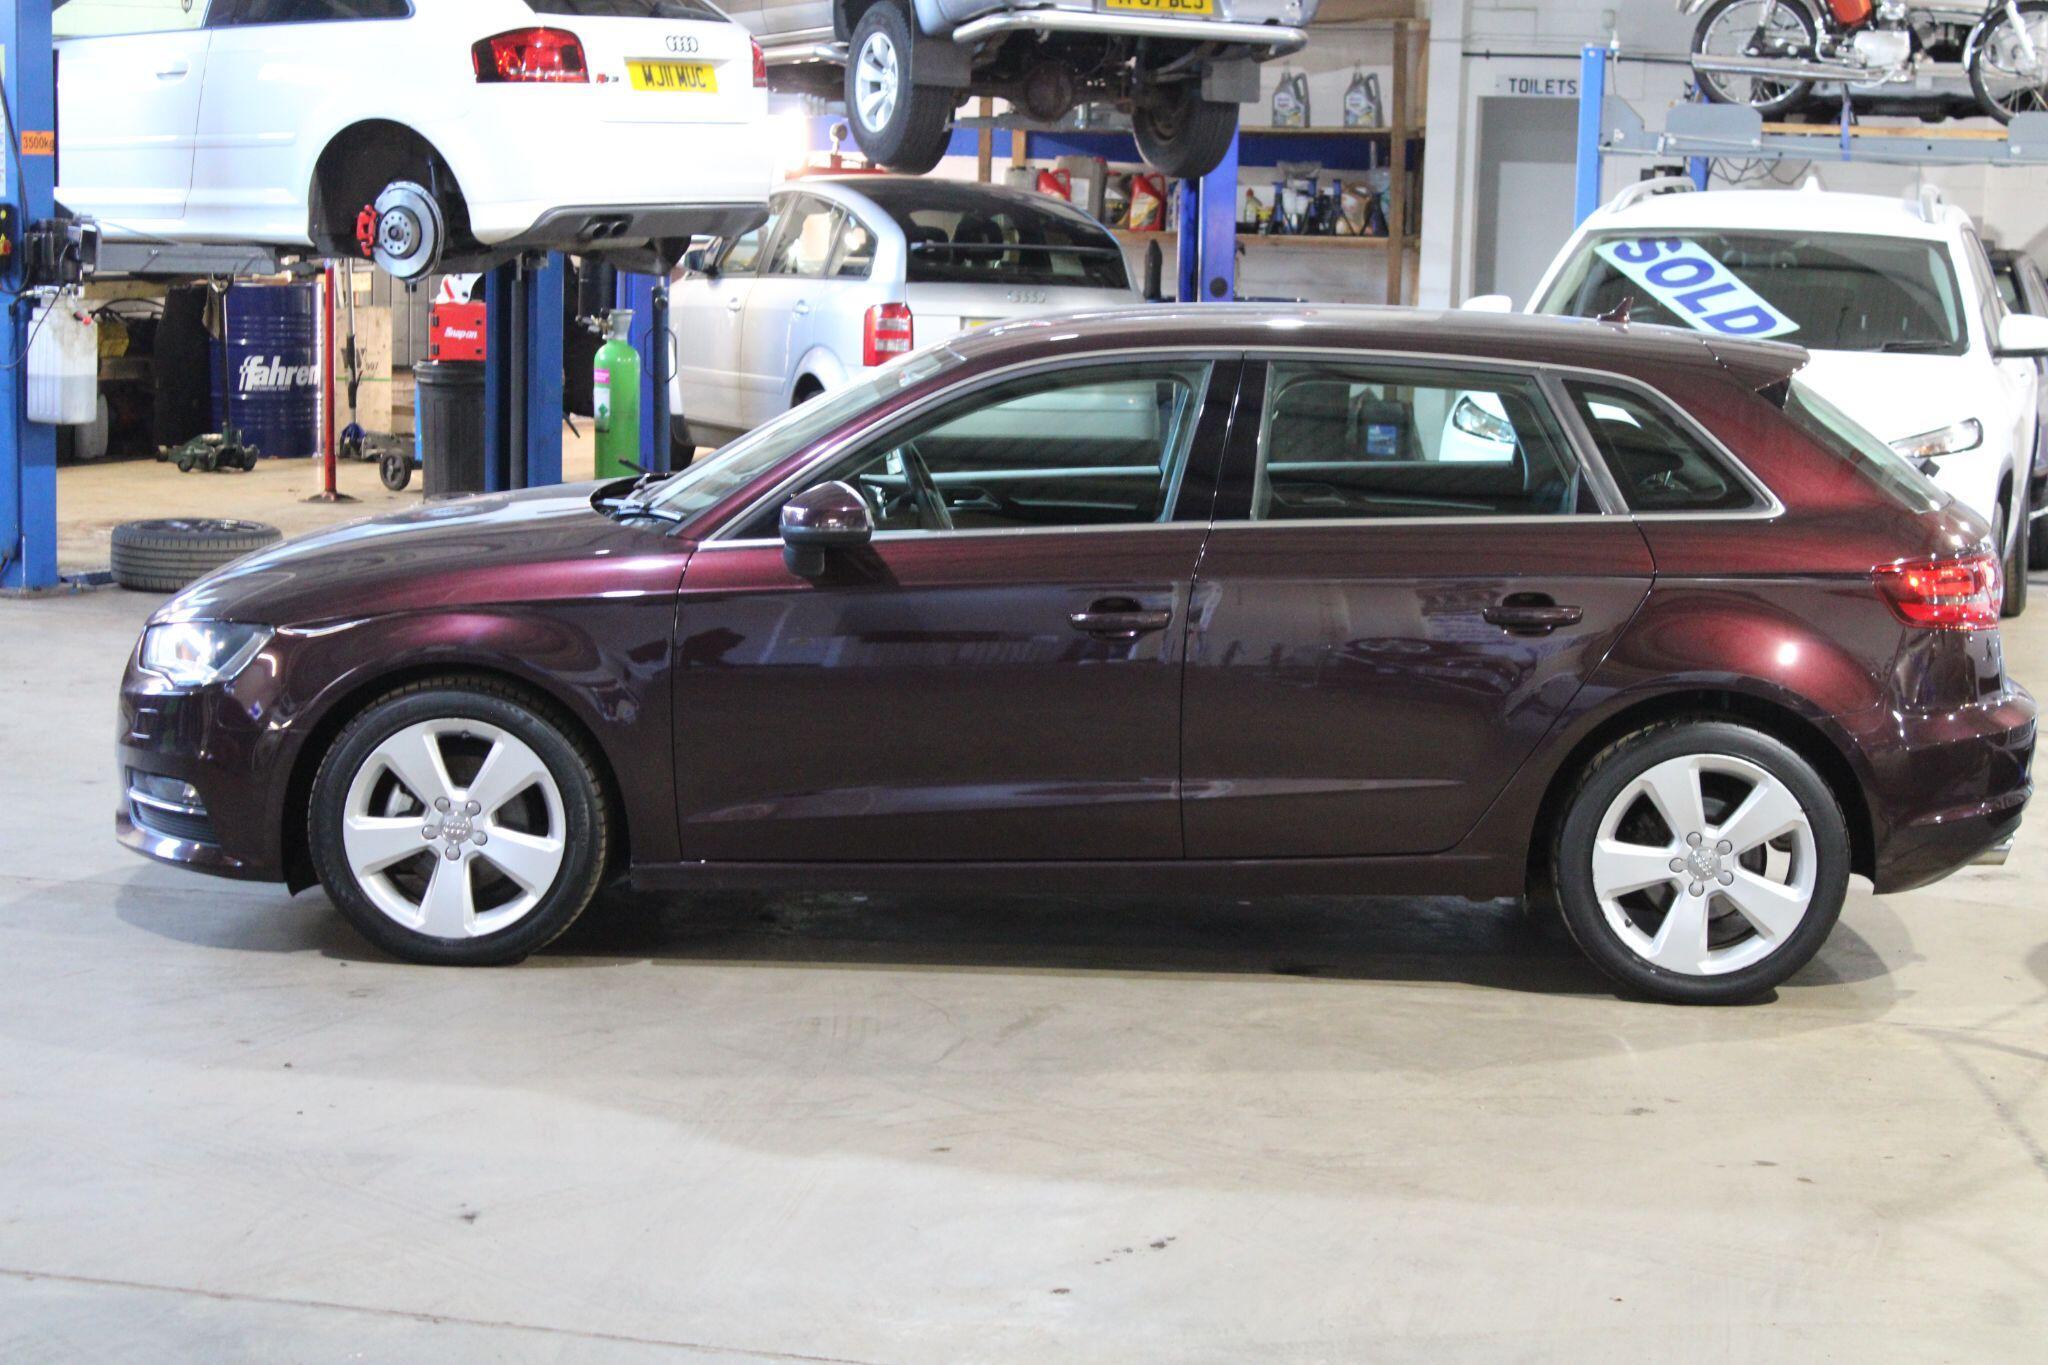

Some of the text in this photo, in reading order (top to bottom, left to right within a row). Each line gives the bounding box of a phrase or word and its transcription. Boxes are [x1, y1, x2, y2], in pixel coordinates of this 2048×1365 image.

[676, 65, 707, 88] MUC
[1508, 78, 1577, 95] TOILETS
[22, 135, 55, 151] 3500kg
[1613, 237, 1778, 335] SOLD
